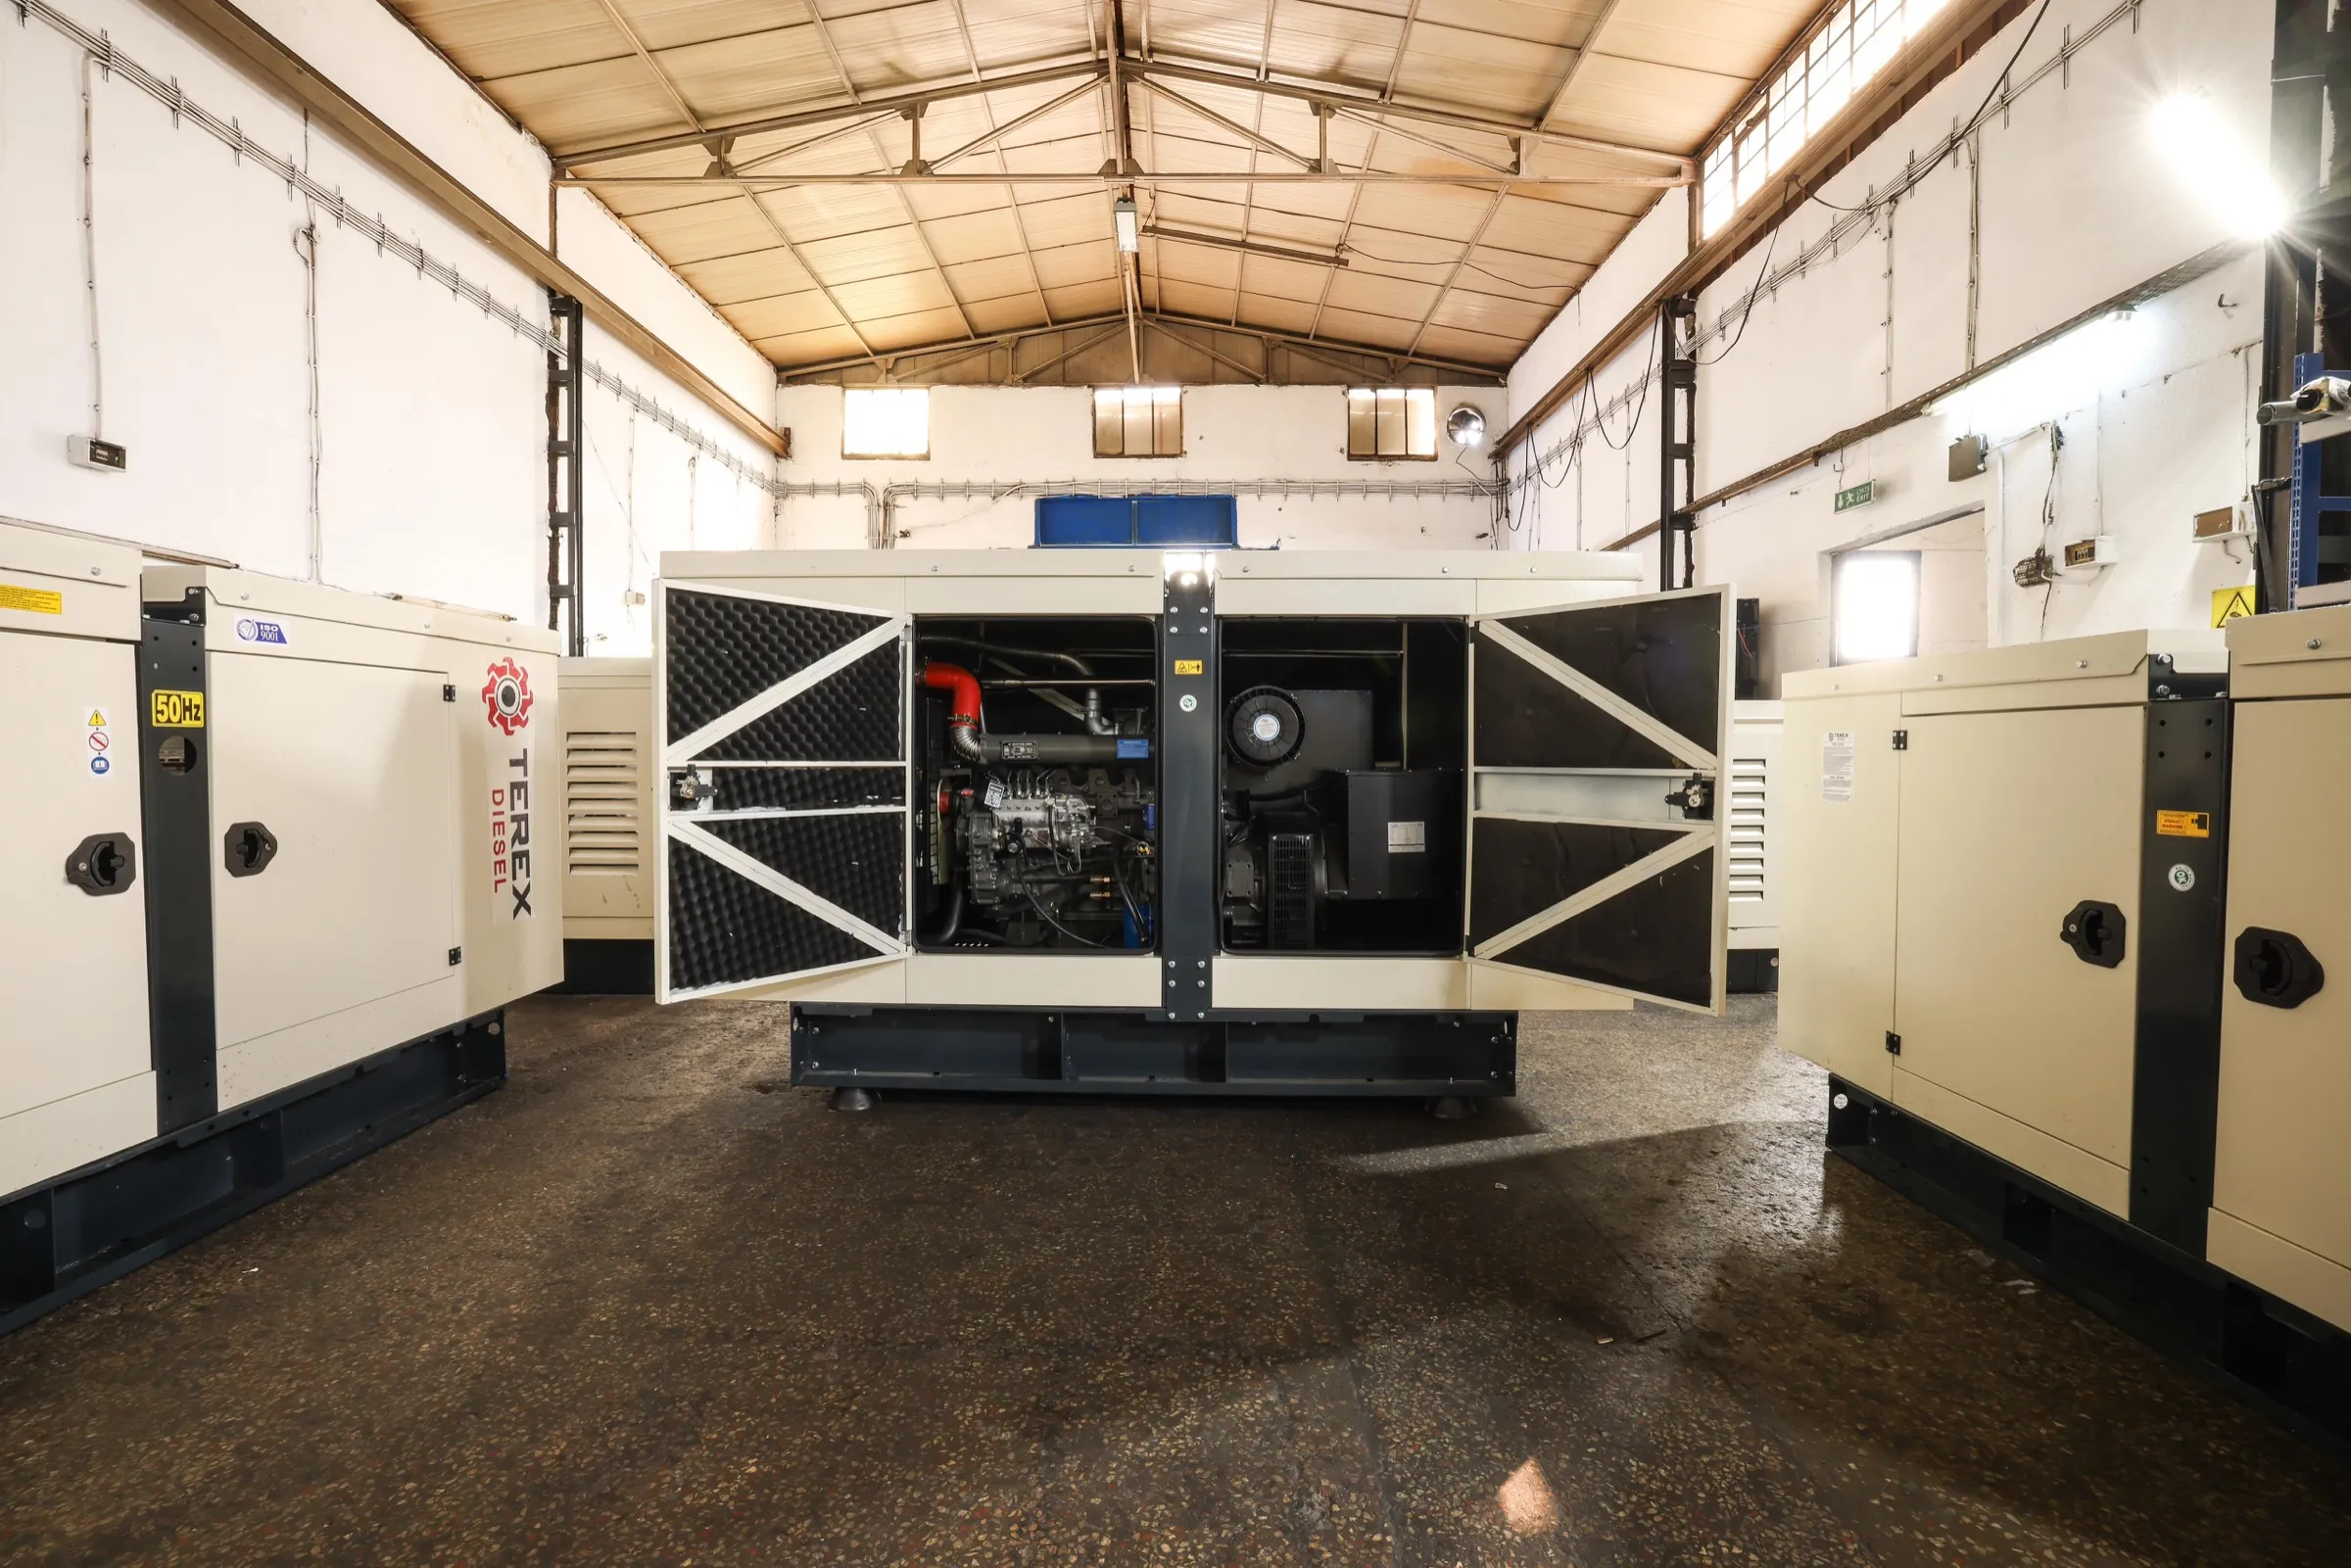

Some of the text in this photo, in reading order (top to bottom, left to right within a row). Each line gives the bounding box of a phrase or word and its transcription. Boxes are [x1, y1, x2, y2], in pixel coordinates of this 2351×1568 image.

[1856, 493, 1870, 501] EXIT
[260, 630, 279, 641] 9001
[156, 694, 201, 723] 50Hz
[492, 788, 507, 893] DIESEL
[509, 748, 531, 921] TEREX
